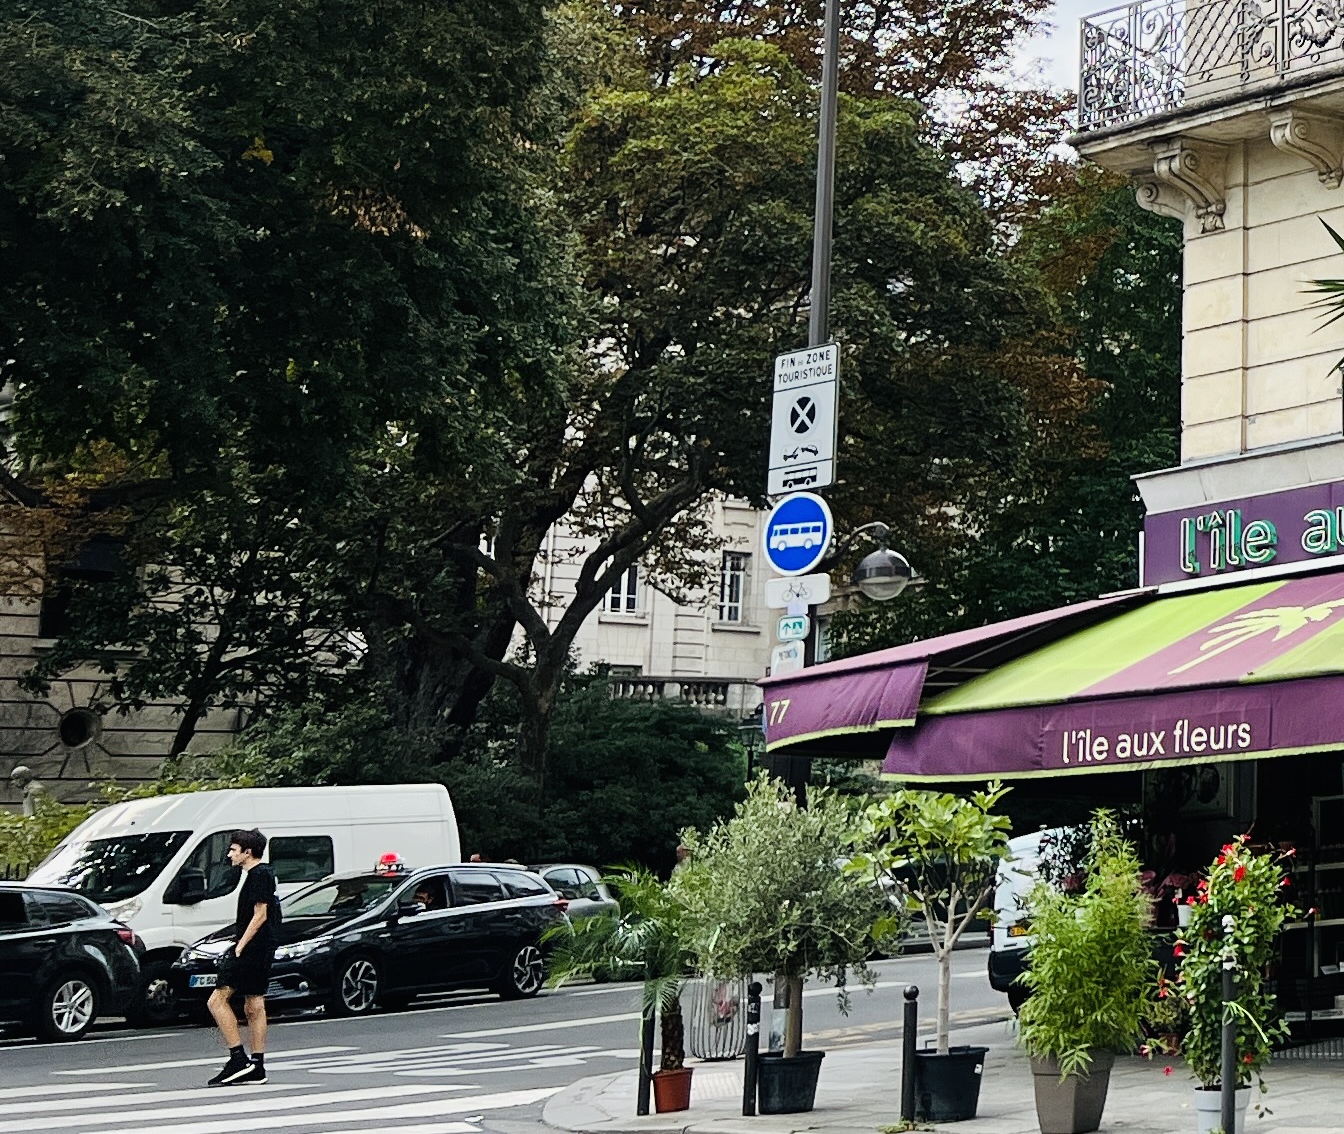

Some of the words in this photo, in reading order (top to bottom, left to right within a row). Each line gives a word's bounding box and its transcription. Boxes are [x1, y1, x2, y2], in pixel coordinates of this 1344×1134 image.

[778, 364, 832, 384] TOURISTIQUE
[781, 357, 795, 369] FIN
[806, 350, 830, 364] ZONE
[1180, 508, 1277, 574] l'île
[1062, 729, 1109, 764] l'île
[1116, 731, 1167, 759] aux
[1173, 719, 1251, 753] fleurs
